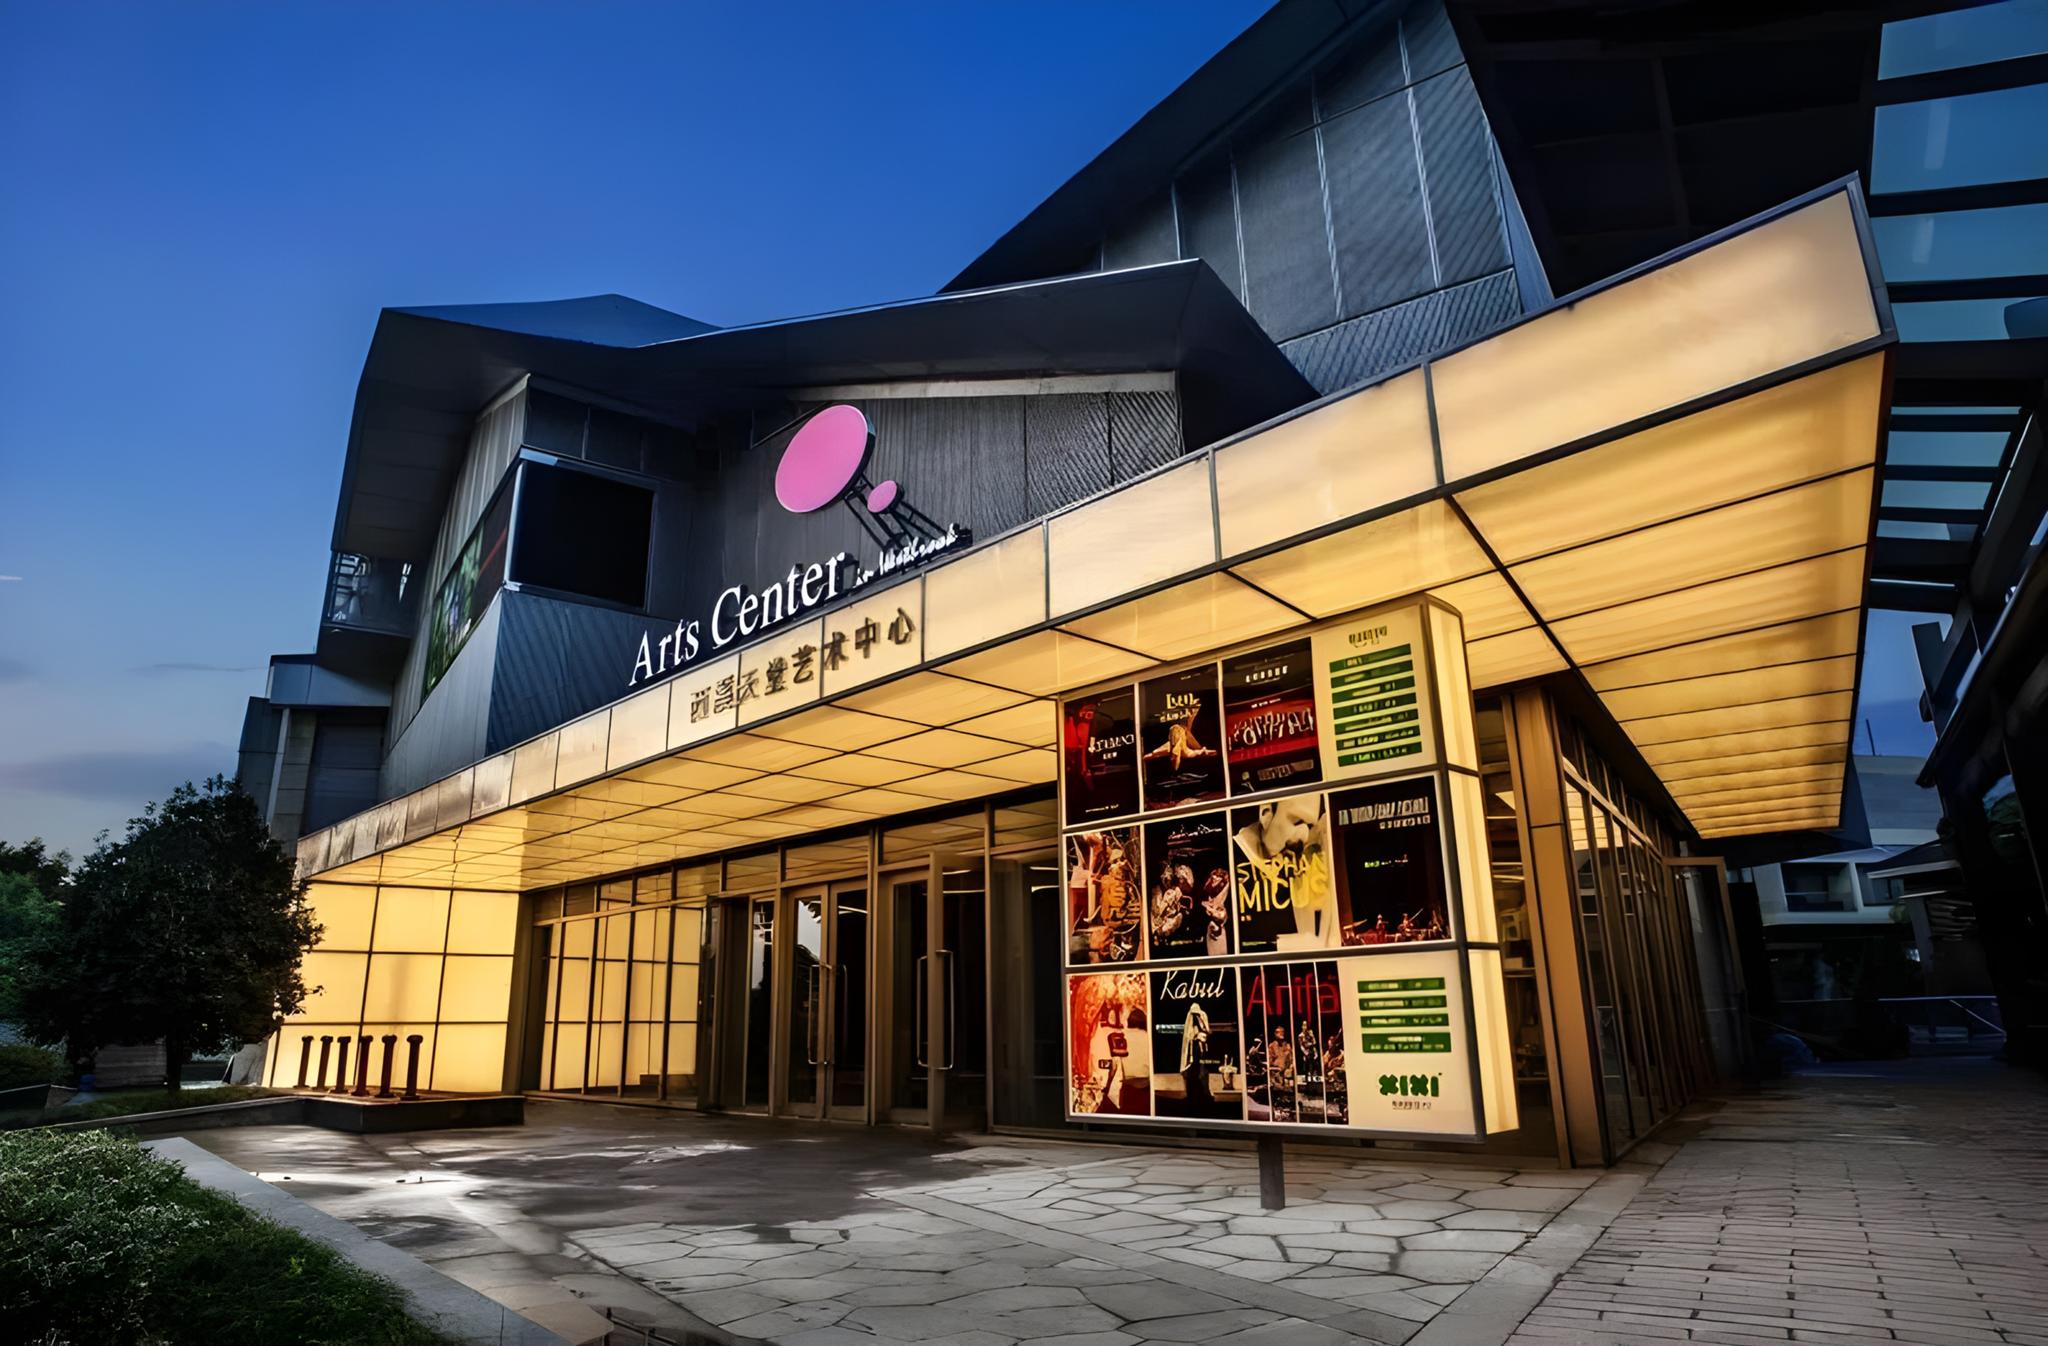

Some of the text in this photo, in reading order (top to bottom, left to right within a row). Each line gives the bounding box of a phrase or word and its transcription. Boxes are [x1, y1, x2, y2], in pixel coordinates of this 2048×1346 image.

[629, 618, 700, 686] Arts
[711, 551, 845, 650] Center
[1238, 871, 1330, 914] MICUS
[1160, 967, 1225, 1000] Kabul
[1246, 972, 1340, 1024] Arifa
